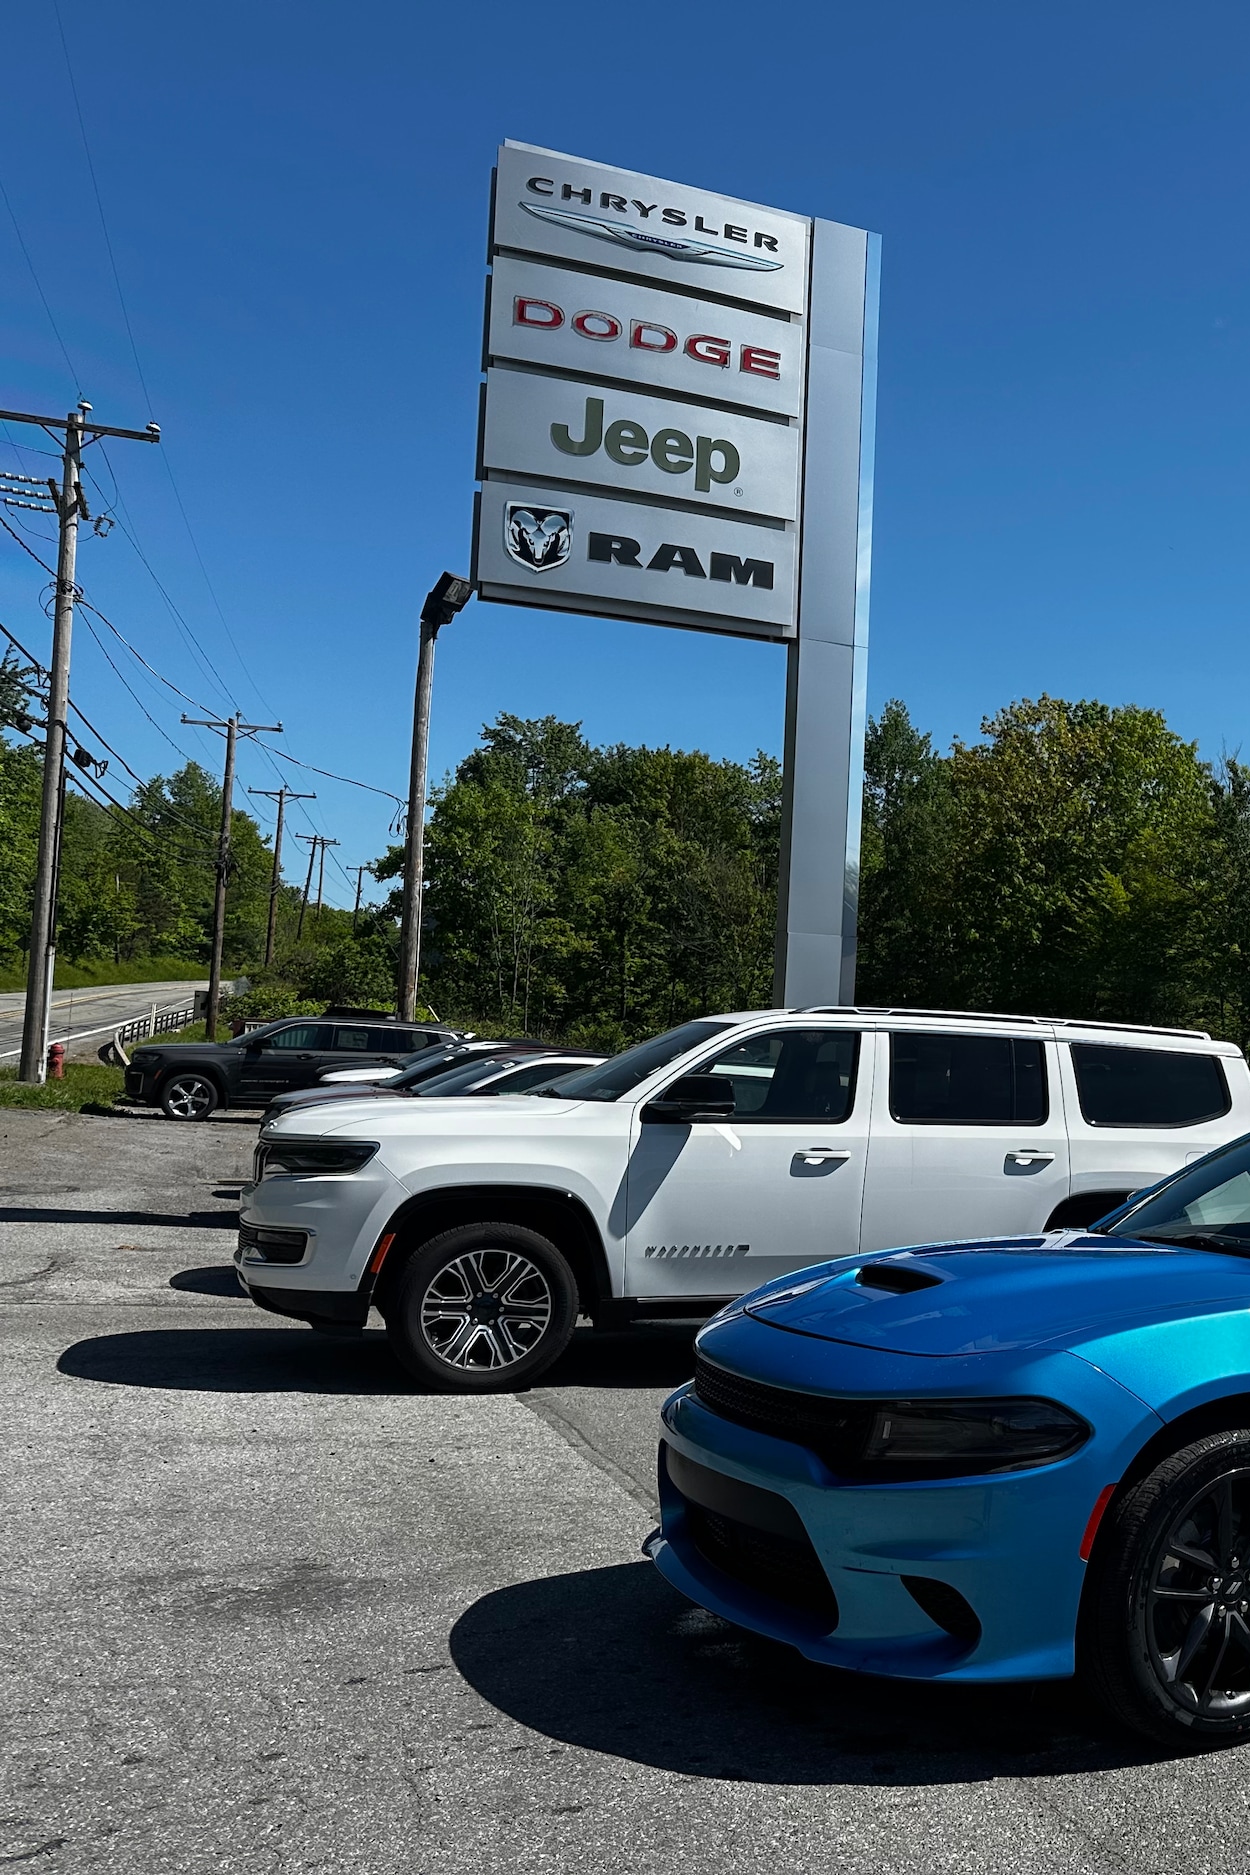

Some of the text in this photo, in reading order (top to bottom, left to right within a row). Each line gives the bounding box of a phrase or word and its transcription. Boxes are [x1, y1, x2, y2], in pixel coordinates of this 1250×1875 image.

[526, 177, 779, 252] CHRYSLER
[631, 233, 683, 248] CHRYSLER
[512, 295, 781, 380] DODGE
[551, 397, 740, 493] Jeep
[587, 531, 774, 590] RAM
